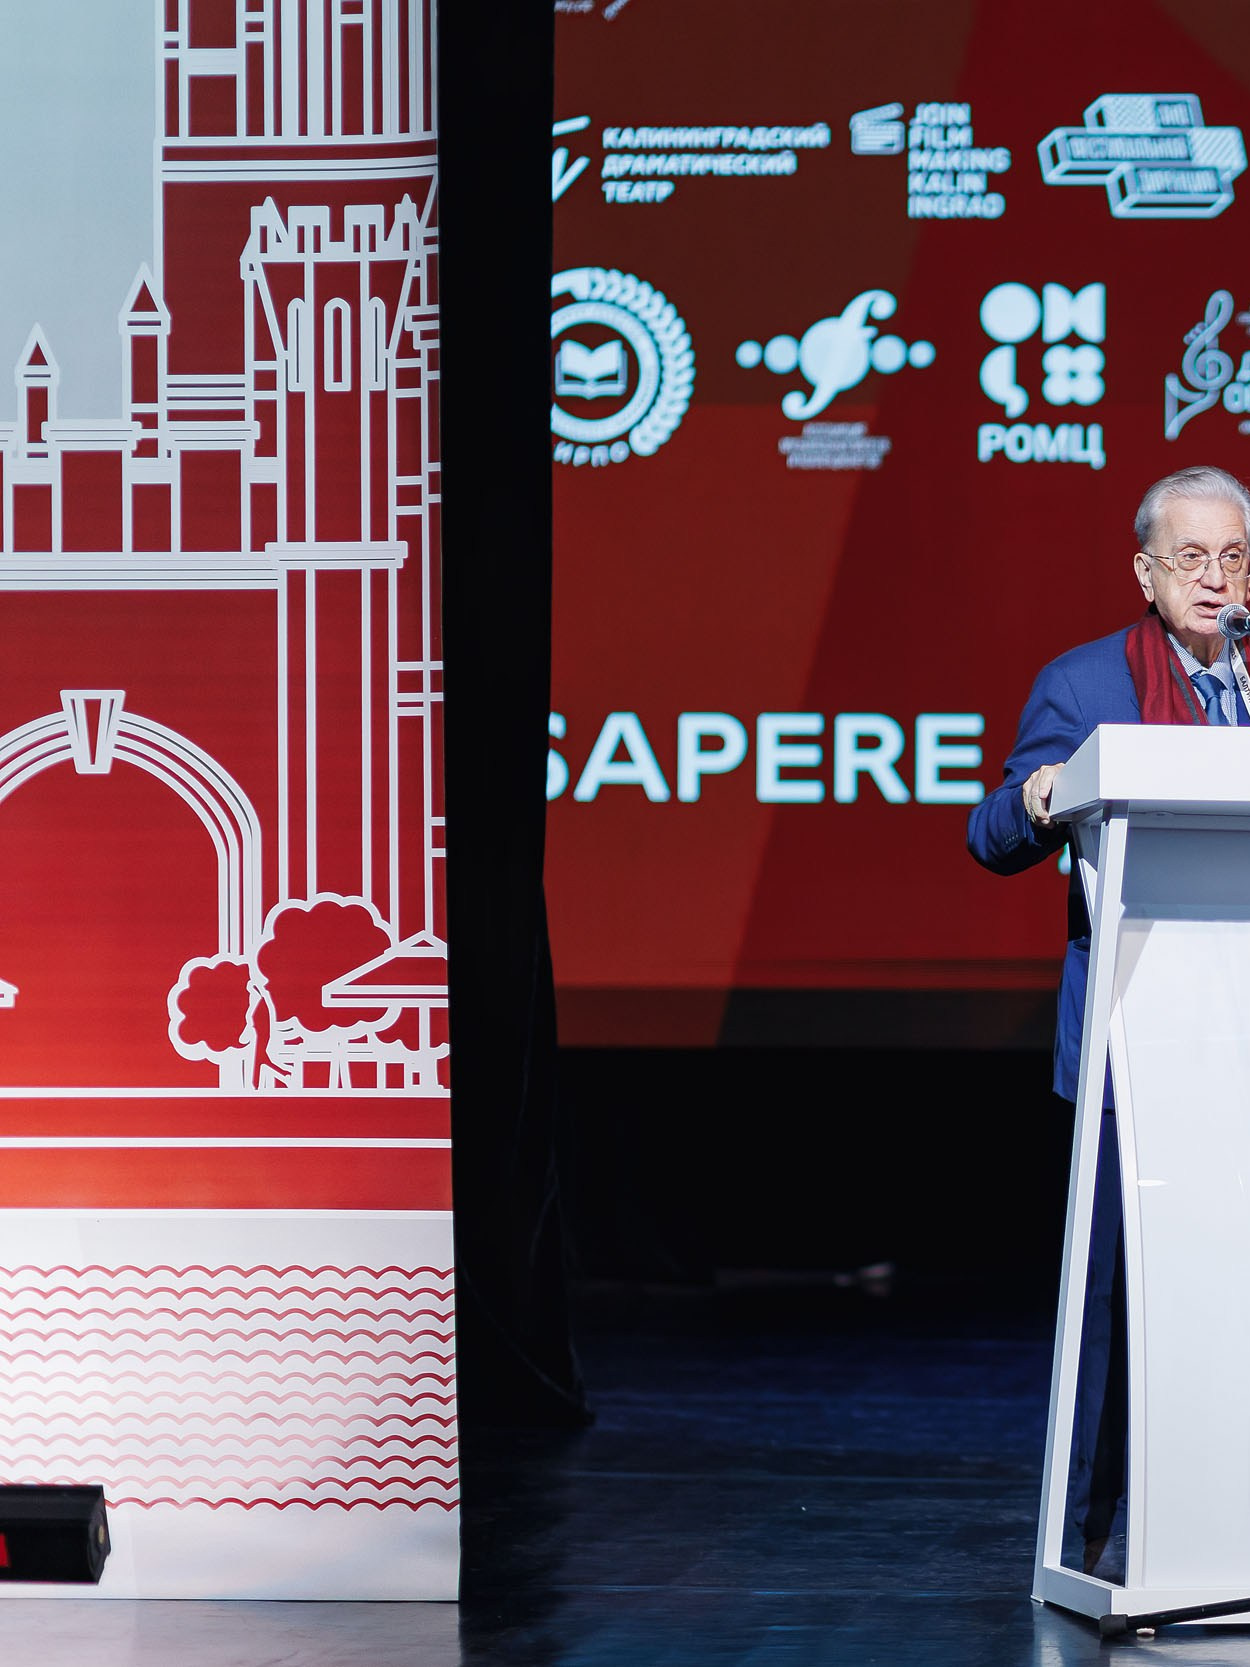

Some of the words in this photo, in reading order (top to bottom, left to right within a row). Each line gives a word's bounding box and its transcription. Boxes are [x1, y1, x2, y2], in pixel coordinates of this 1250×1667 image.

[909, 102, 971, 126] JOIN
[603, 123, 831, 149] КАЛИНИНГРАДСКИЙ
[908, 125, 973, 148] FILM
[601, 151, 797, 178] ДРАМАТИЧЕСКИЙ
[908, 147, 1011, 173] MAKING
[602, 181, 675, 203] ТЕАТР
[908, 171, 987, 195] KALIN
[908, 193, 1005, 219] INGRAD
[978, 423, 1106, 469] РОМЦ
